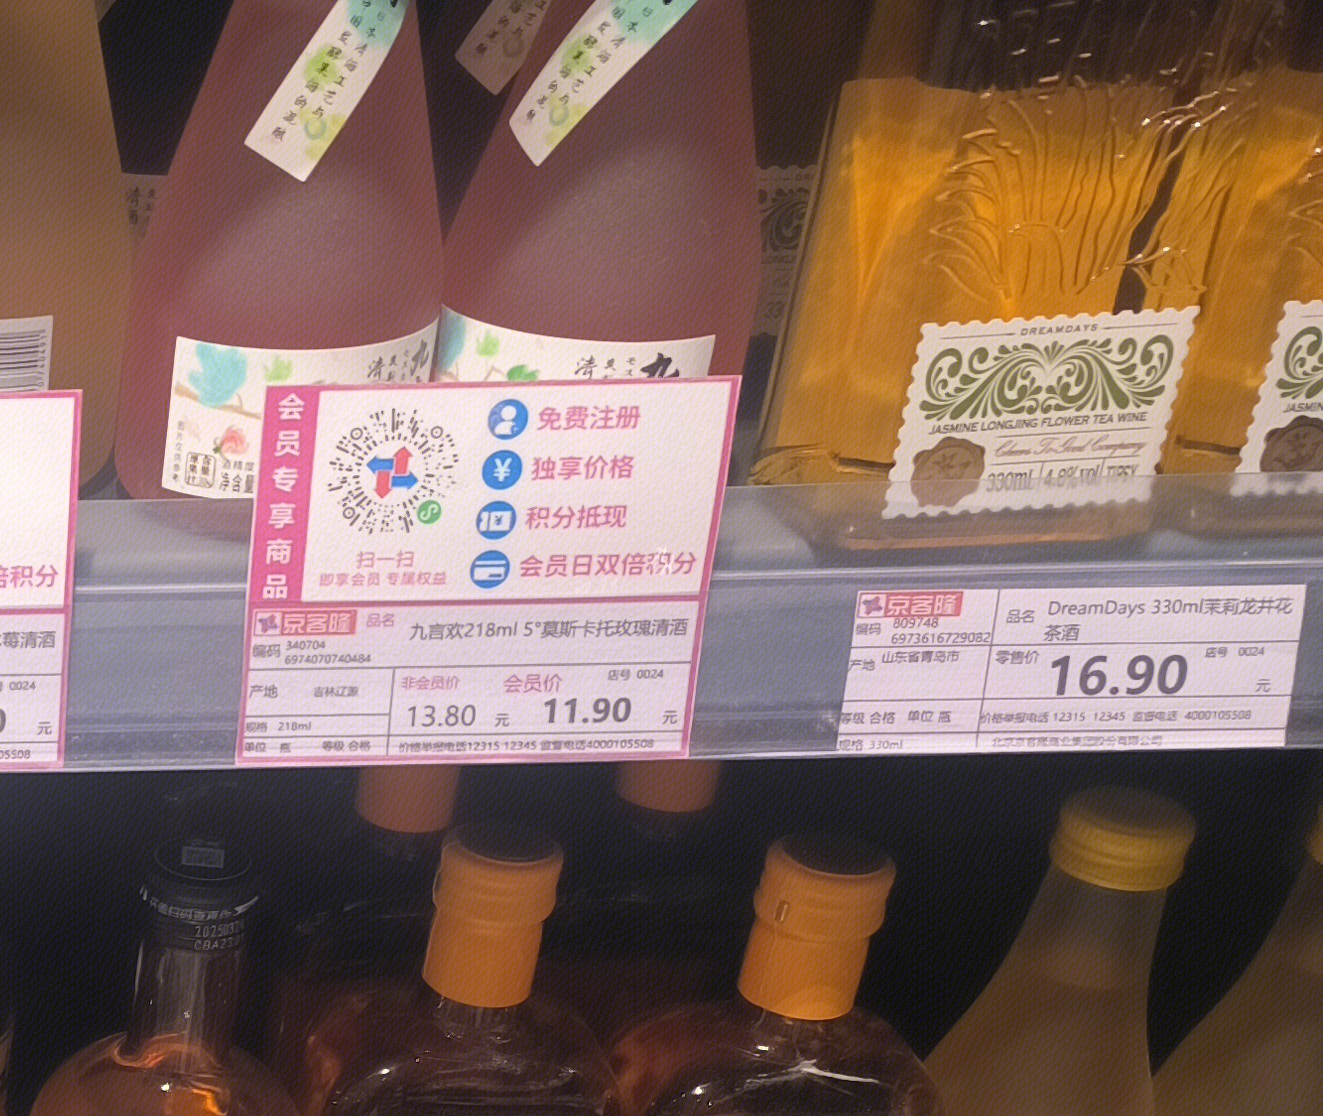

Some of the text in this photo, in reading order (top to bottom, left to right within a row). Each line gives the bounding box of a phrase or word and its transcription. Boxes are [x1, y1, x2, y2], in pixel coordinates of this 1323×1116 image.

[537, 405, 641, 431] 免费注册
[928, 411, 1147, 435] JASMINE LONGJING FLOWER TEA WINE
[531, 455, 634, 481] 独享价格
[262, 393, 305, 600] 会员专享商品
[526, 505, 627, 530] 积分抵现
[519, 552, 697, 578] 会员日双倍积分
[1048, 600, 1145, 617] DreamDays
[1044, 624, 1079, 641] 茶酒
[1052, 654, 1188, 696] 16.90
[407, 698, 631, 728] 13.80 11.90
